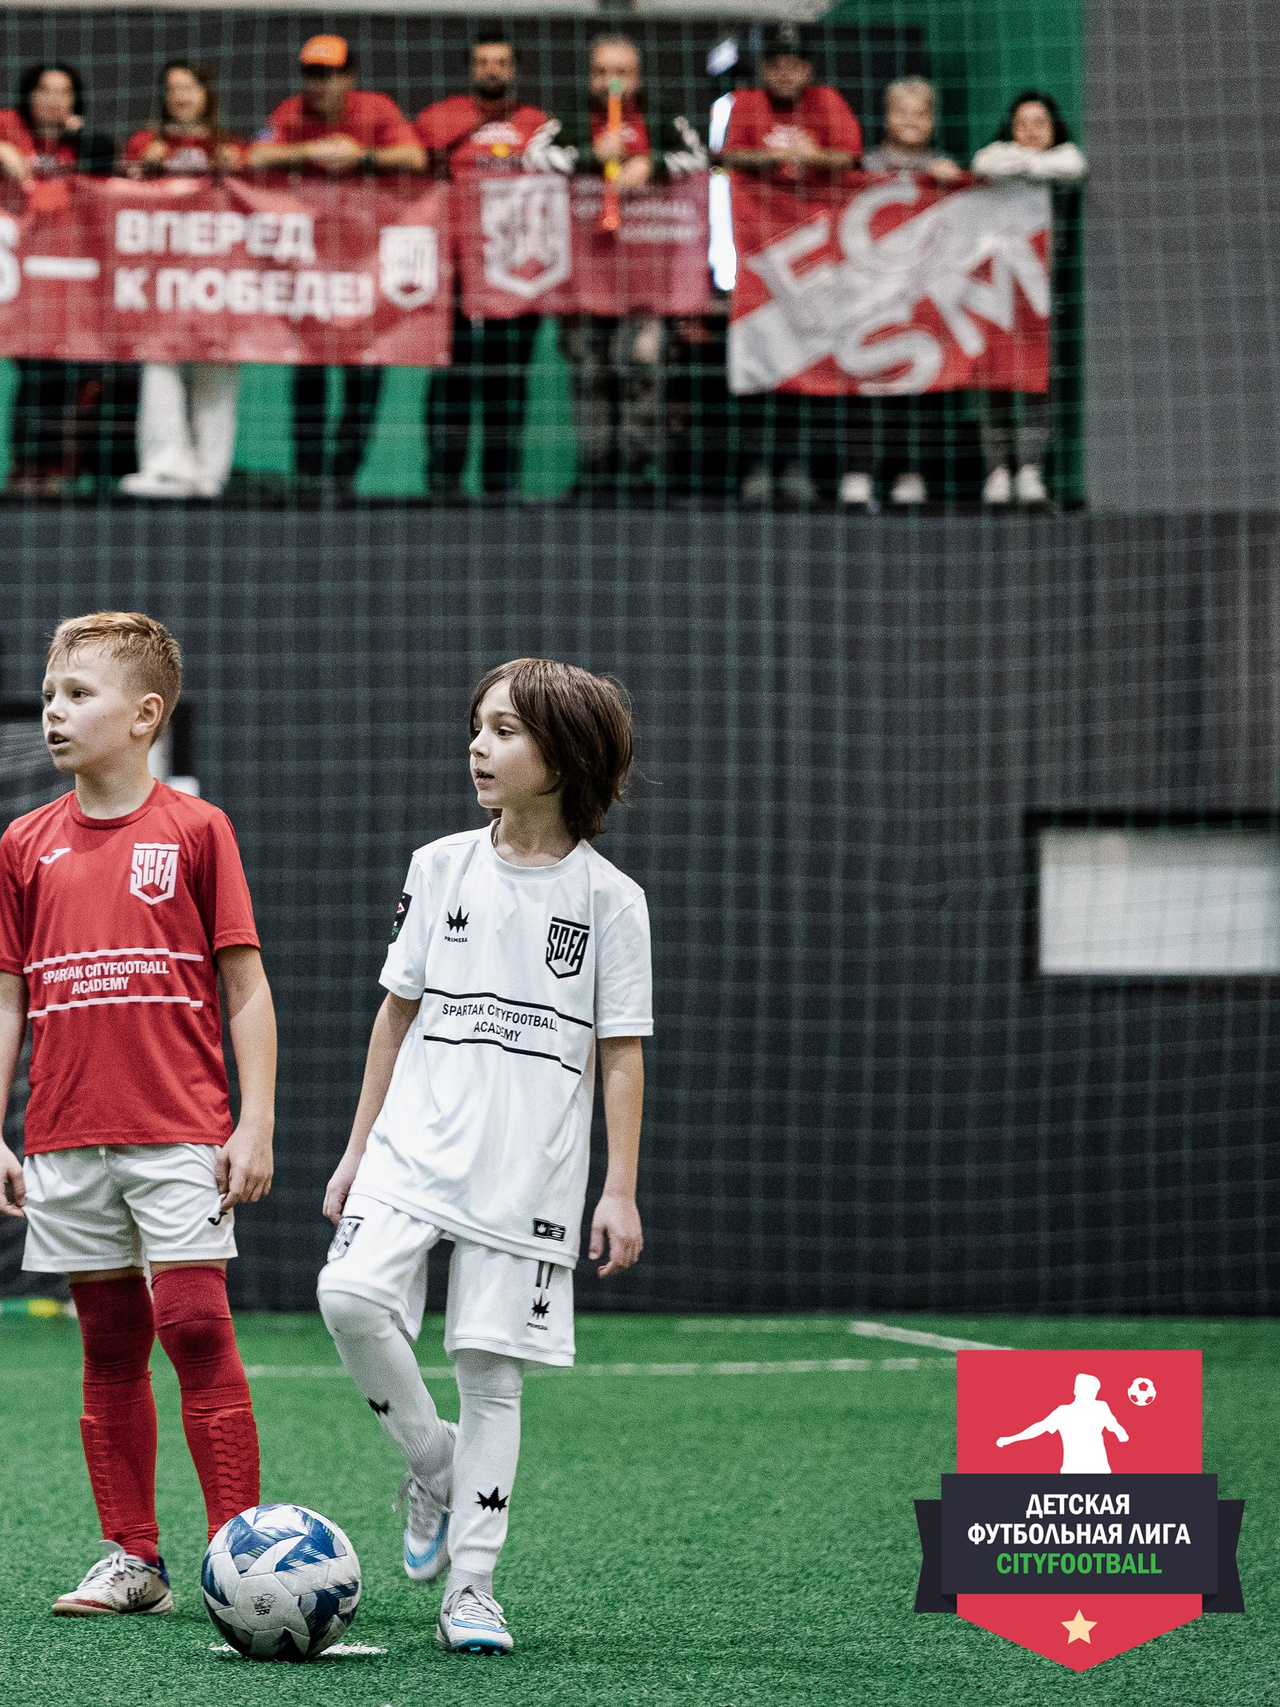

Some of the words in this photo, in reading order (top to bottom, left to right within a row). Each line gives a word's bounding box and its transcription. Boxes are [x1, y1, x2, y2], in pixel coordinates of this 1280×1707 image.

[114, 209, 317, 265] ВПЕРЕД
[114, 267, 150, 312] К
[130, 849, 178, 892] SCFA
[546, 922, 590, 967] SCFA
[43, 967, 83, 984] SPARTAK
[85, 961, 169, 976] CITYFOOTBALL
[72, 977, 129, 994] ACADEMY
[441, 1003, 485, 1017] SPARTAK
[487, 1004, 559, 1032] CITYFOOTBALL
[473, 1021, 522, 1042] ACADEMY
